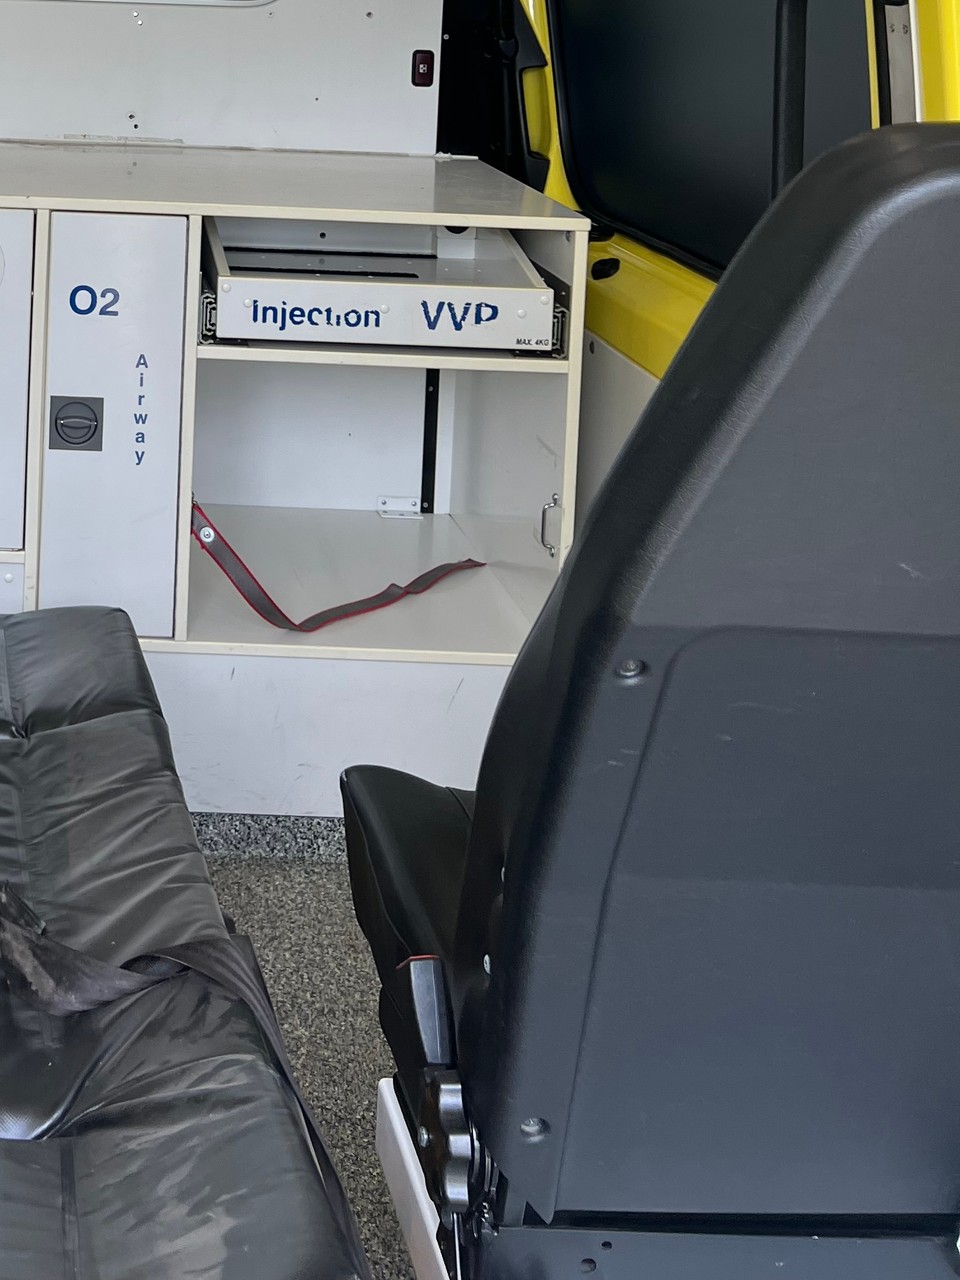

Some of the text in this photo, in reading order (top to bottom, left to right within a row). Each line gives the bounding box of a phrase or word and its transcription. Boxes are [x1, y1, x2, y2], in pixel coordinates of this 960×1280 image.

[69, 285, 120, 317] O2
[420, 300, 499, 332] VVP
[134, 353, 148, 466] Airway
